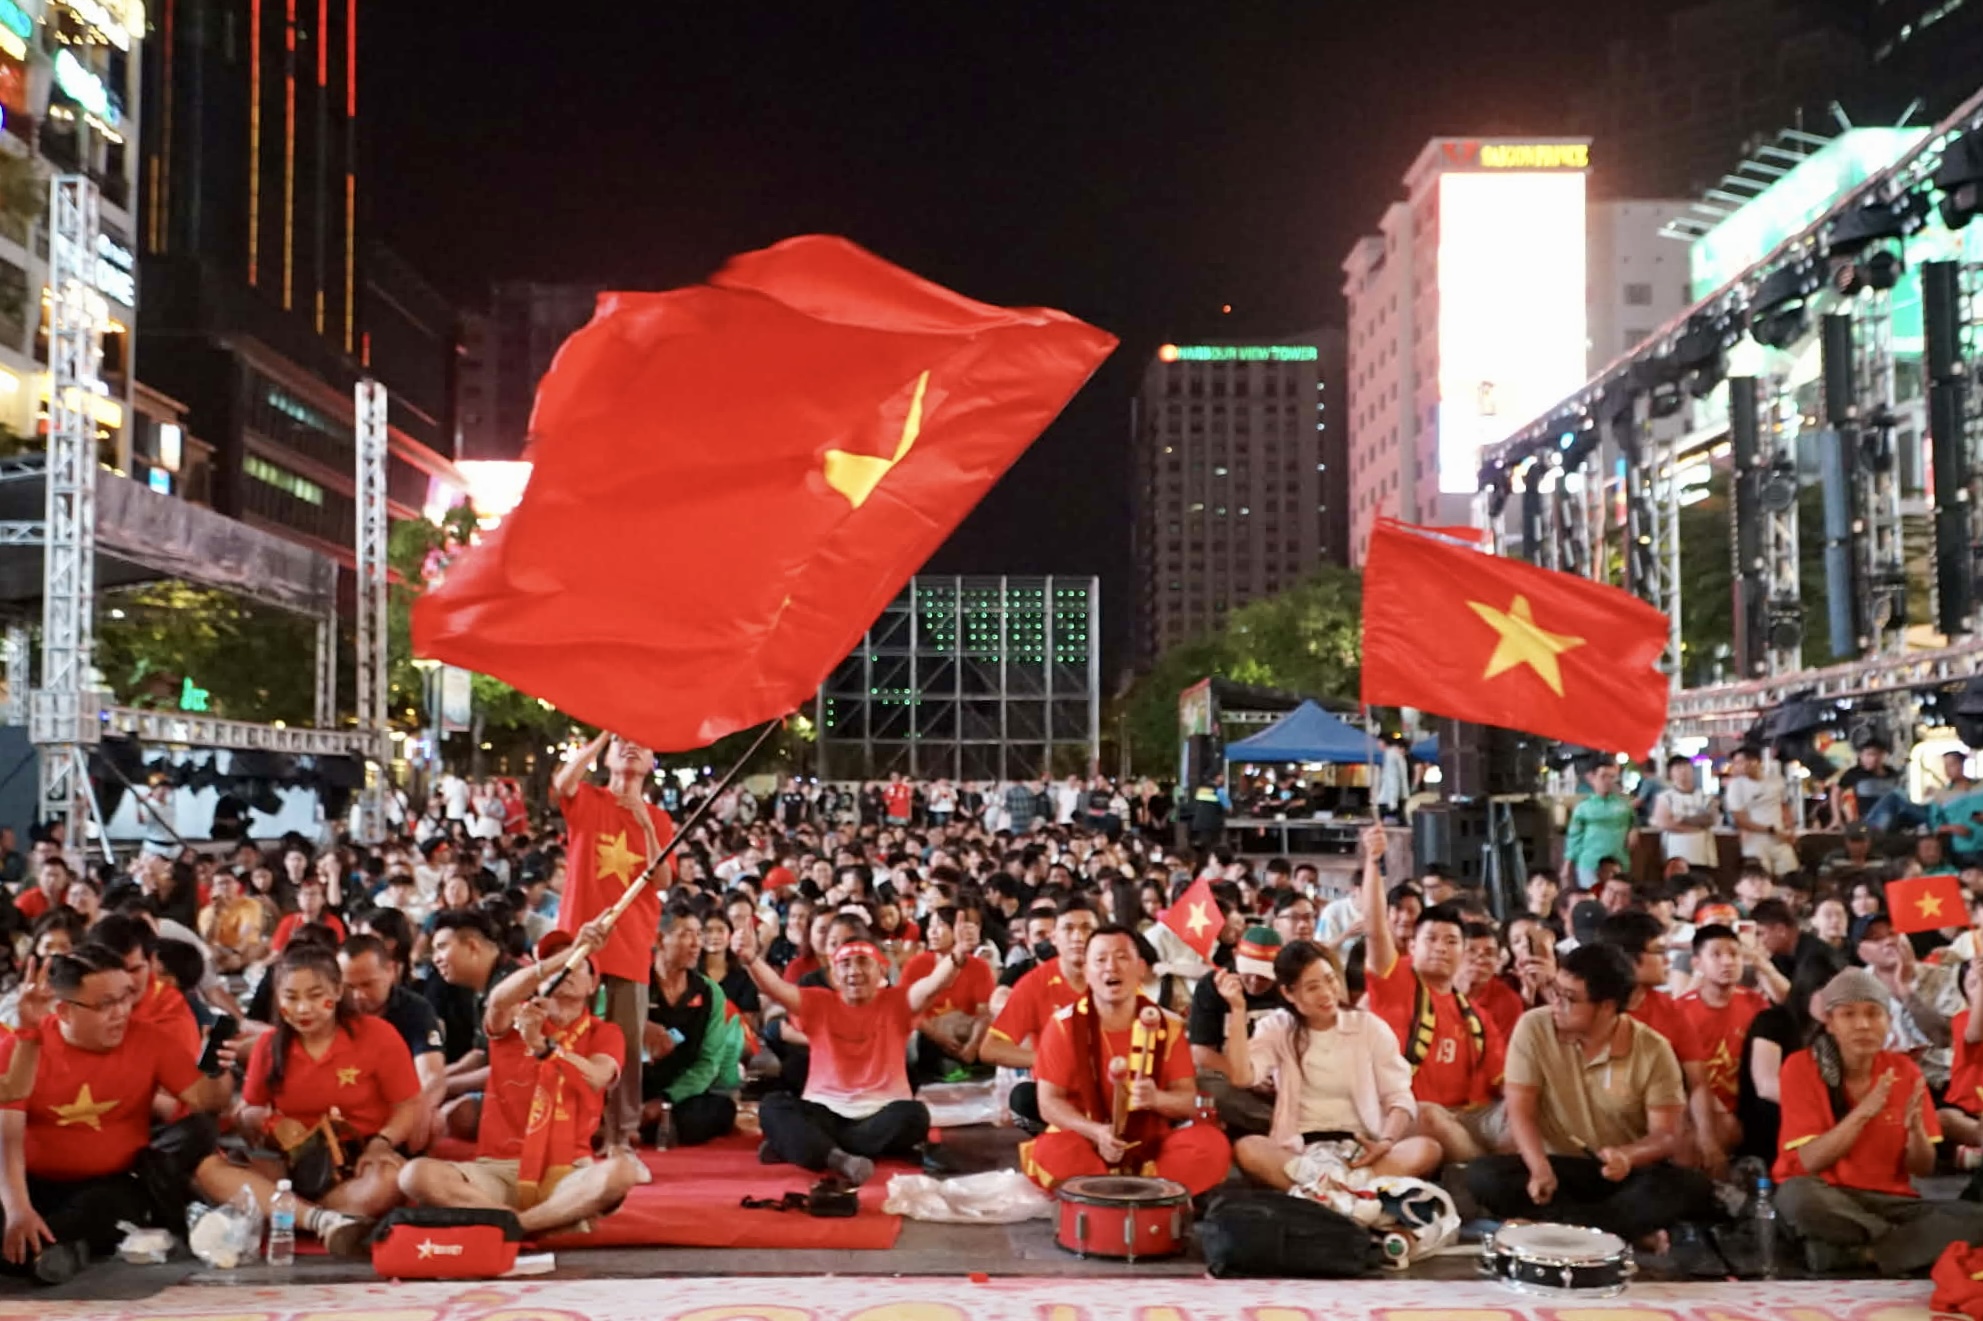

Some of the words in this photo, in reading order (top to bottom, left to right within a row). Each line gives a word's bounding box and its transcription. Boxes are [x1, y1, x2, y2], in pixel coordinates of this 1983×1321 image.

[1239, 346, 1269, 360] VIEW
[1270, 346, 1318, 361] TOWER
[1435, 1038, 1457, 1063] 19
